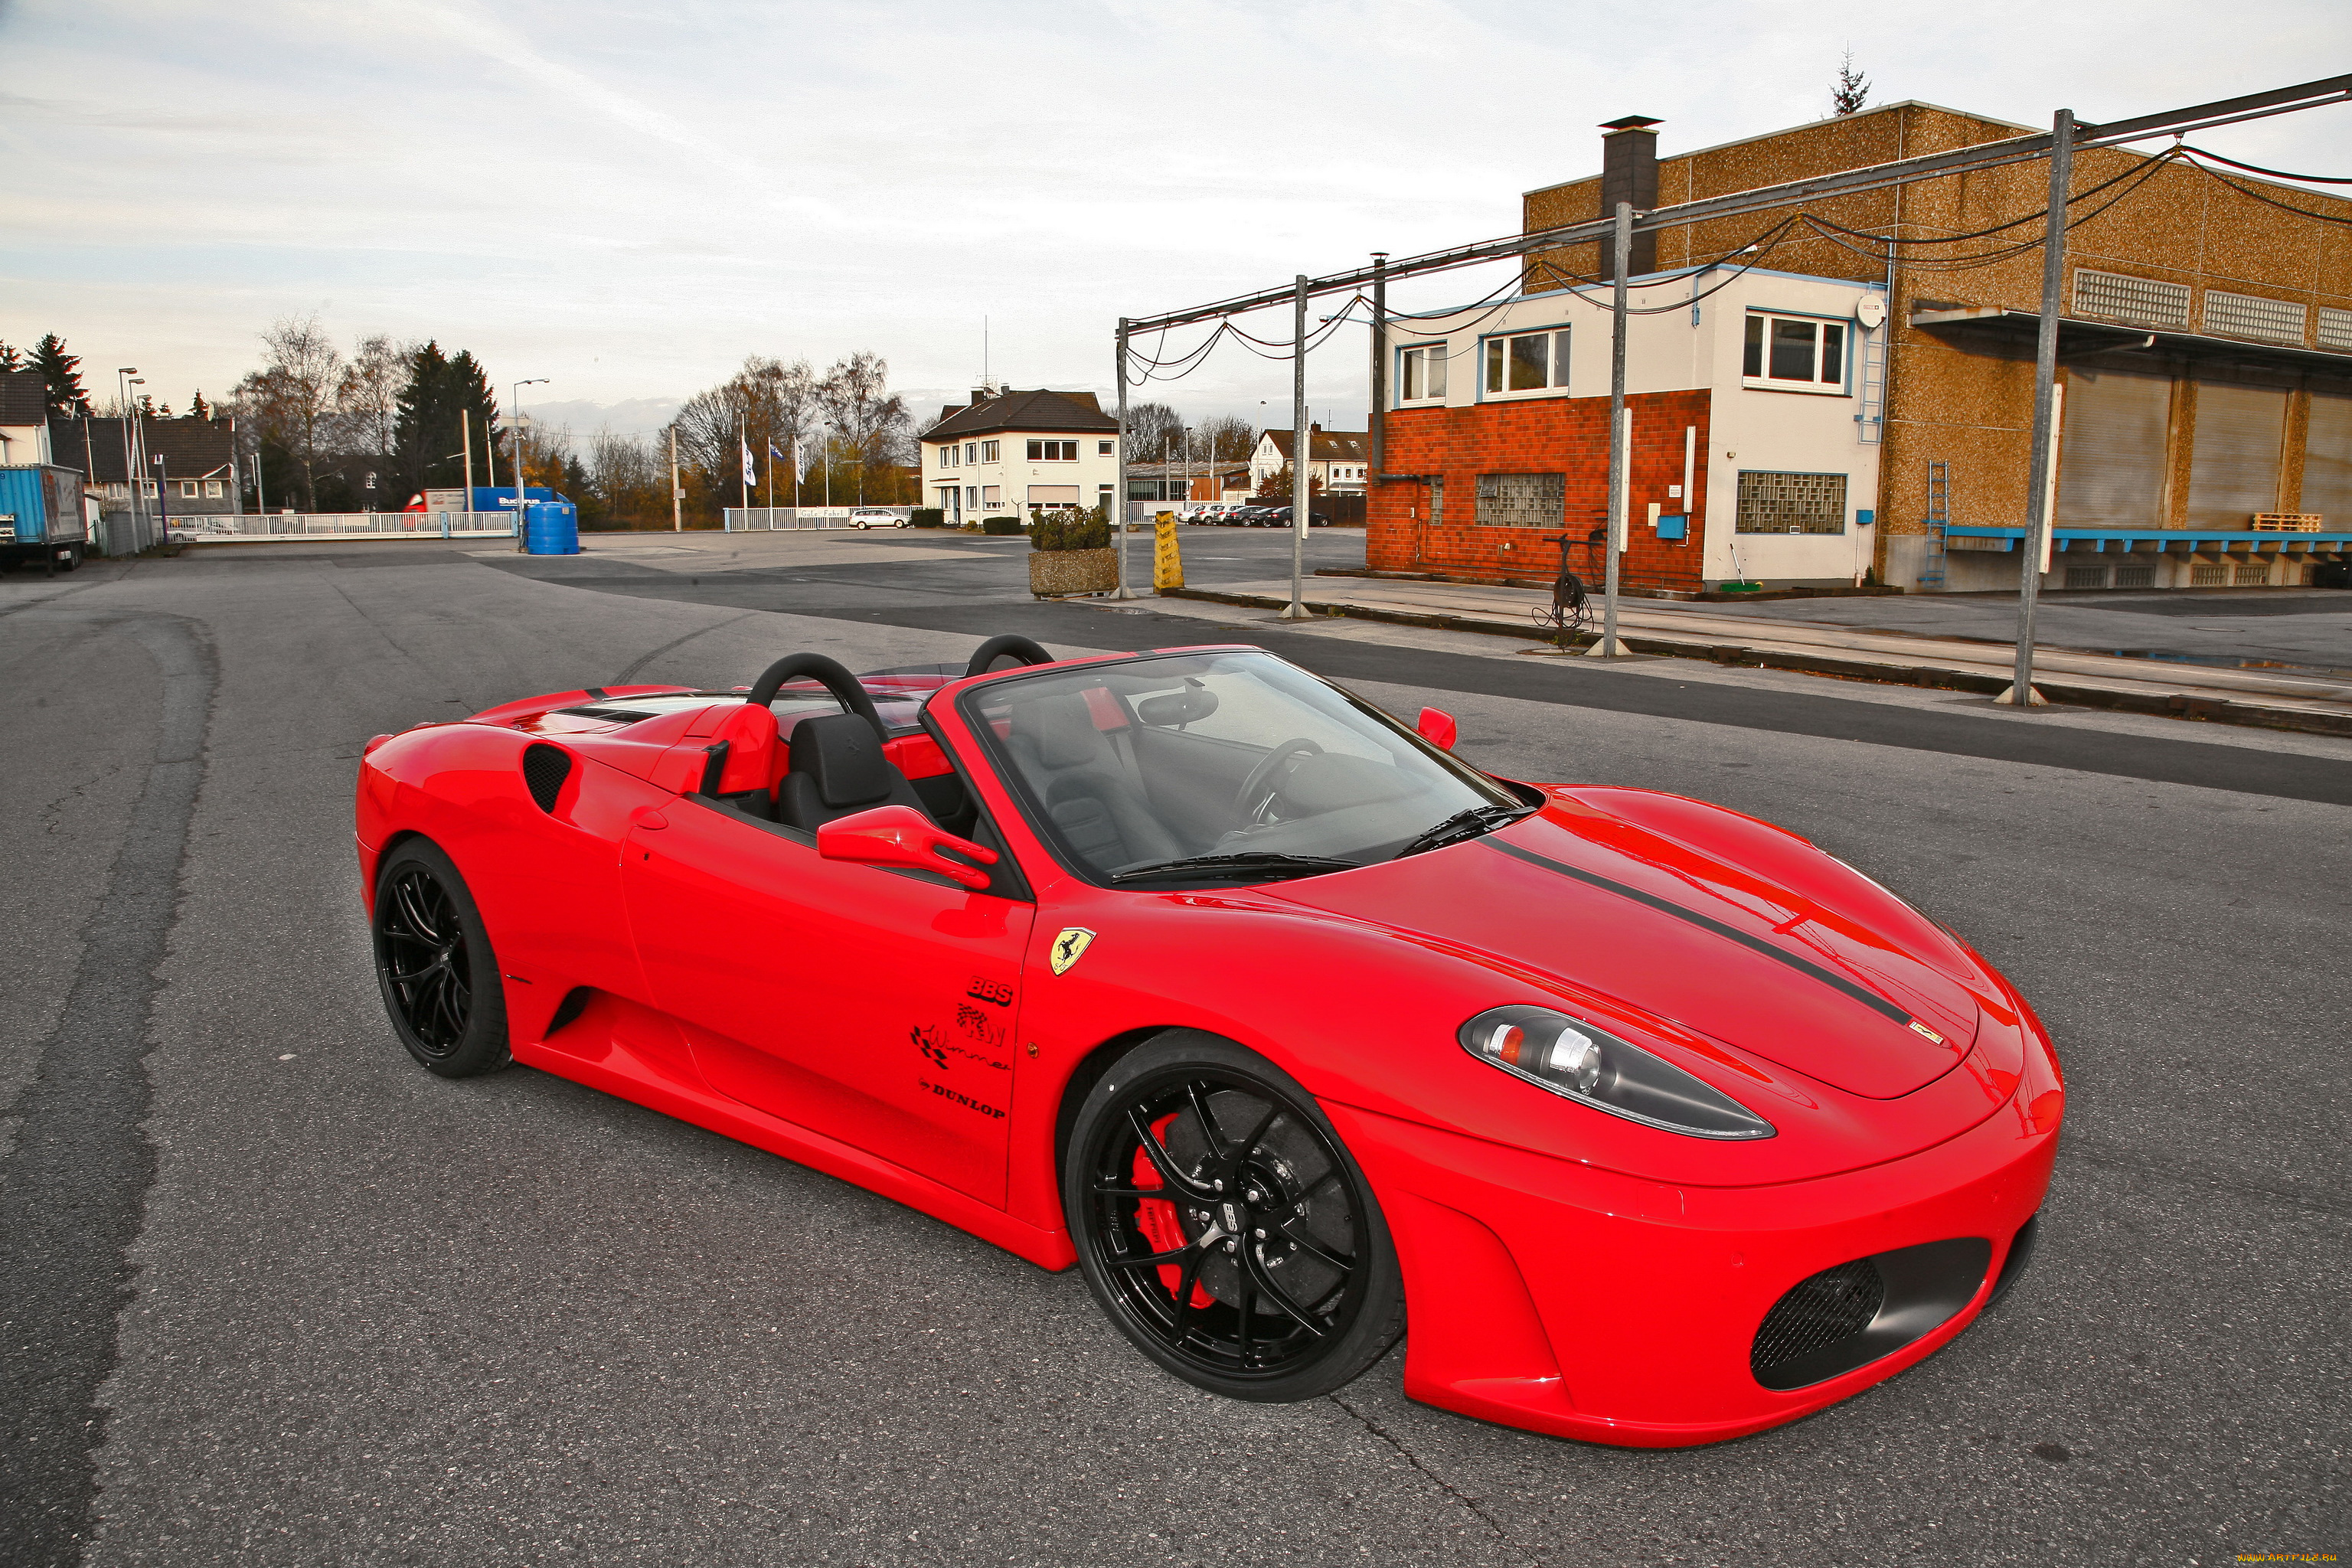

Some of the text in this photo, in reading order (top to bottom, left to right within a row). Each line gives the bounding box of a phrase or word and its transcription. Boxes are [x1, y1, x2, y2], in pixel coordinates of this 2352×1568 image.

[966, 975, 1013, 1008] BBS
[933, 1083, 1005, 1119] DUNLOP
[1223, 1203, 1238, 1232] BBS
